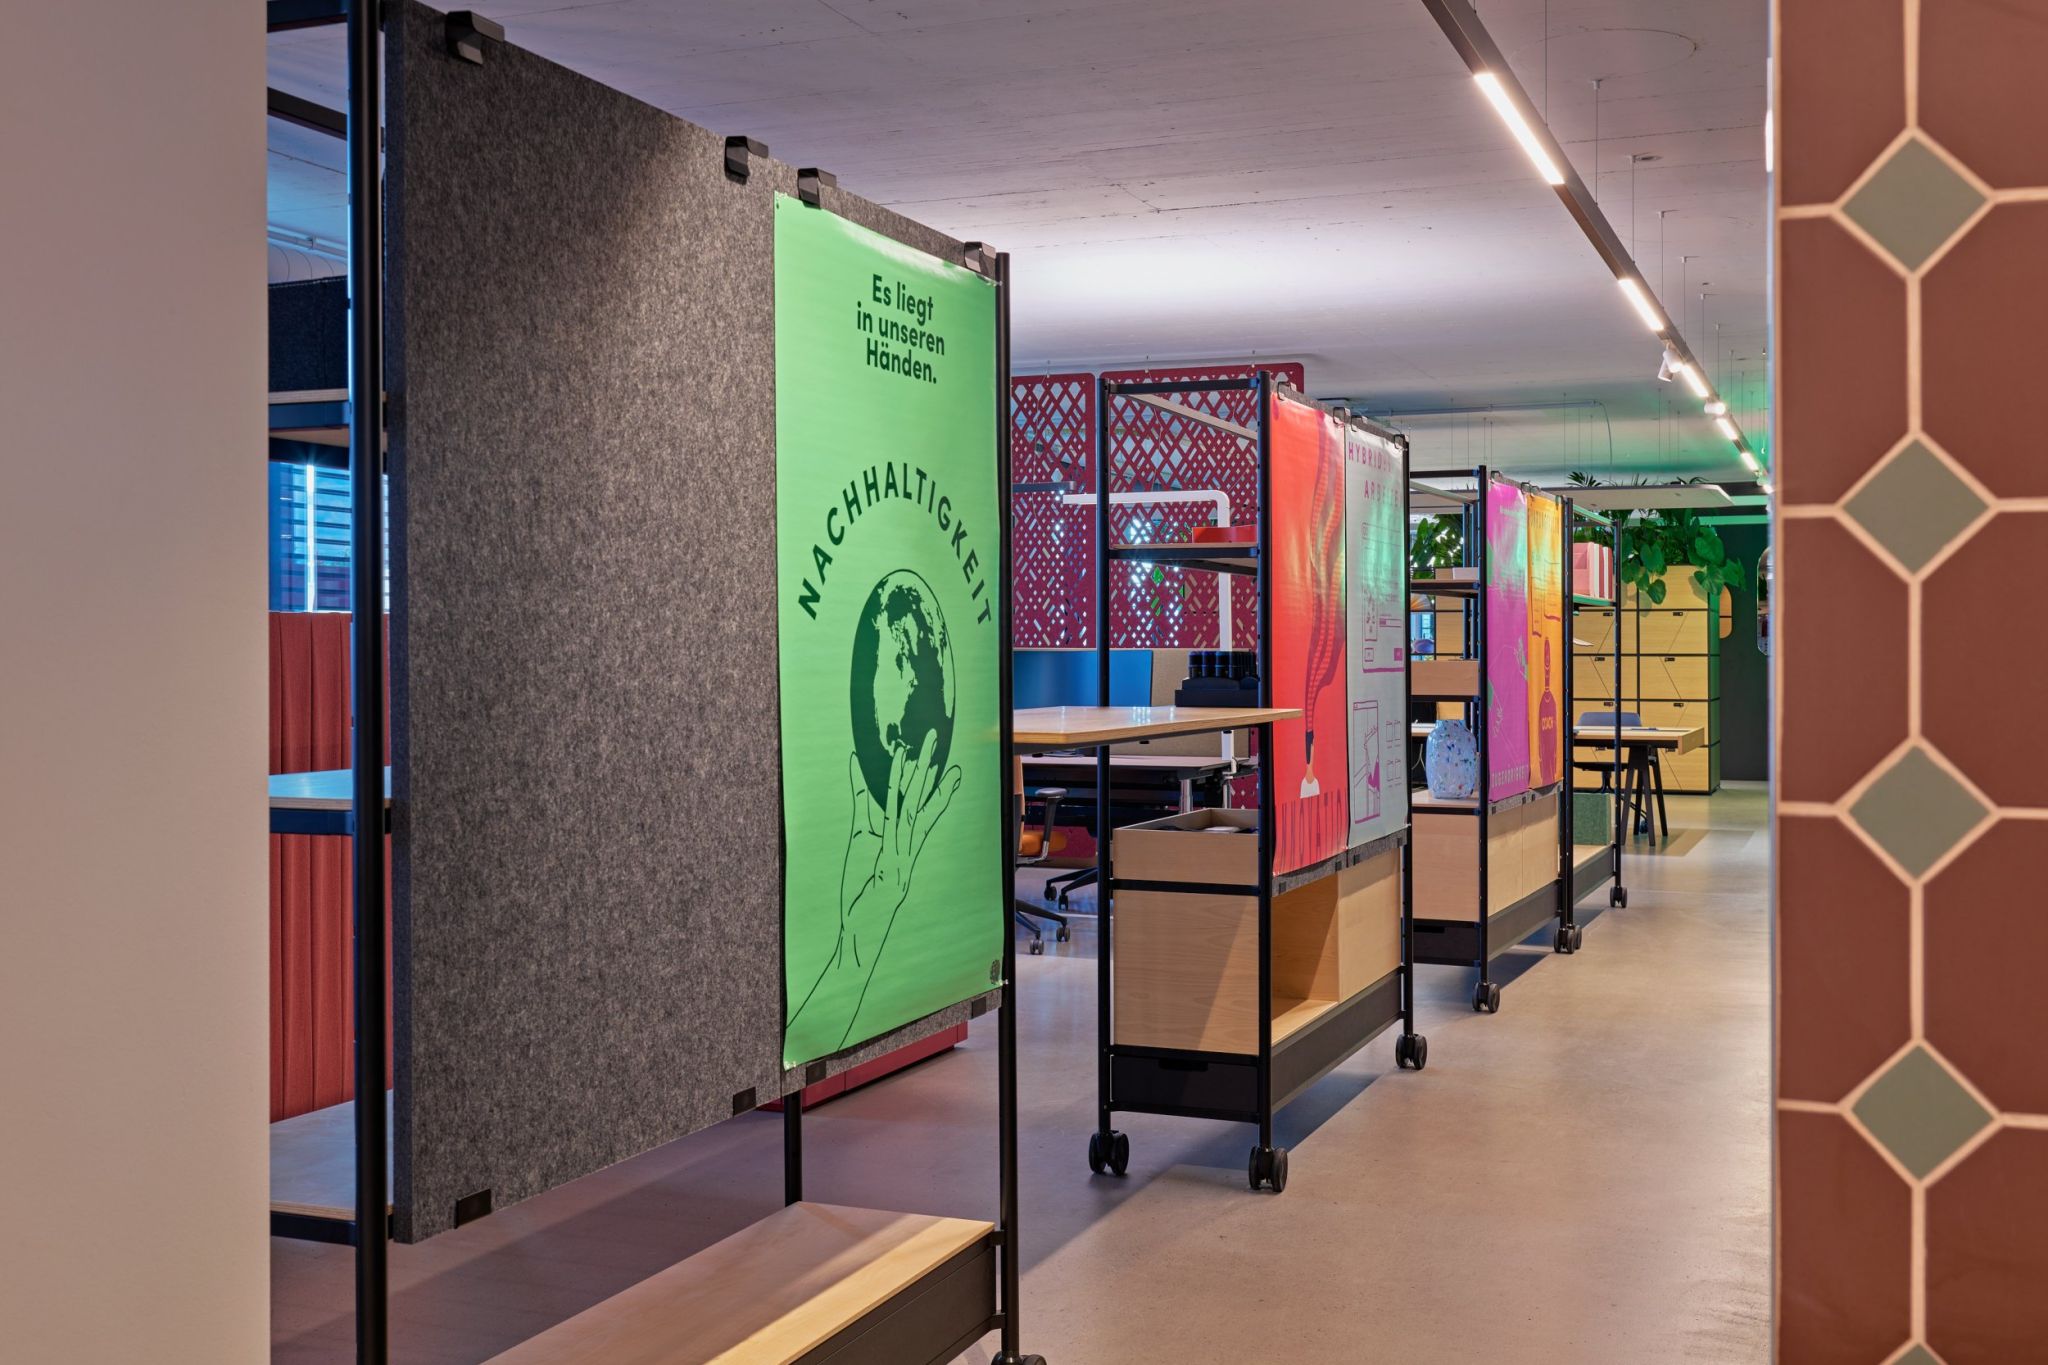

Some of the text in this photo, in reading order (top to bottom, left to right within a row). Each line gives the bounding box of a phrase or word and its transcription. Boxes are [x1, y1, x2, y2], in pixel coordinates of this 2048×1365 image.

[872, 274, 934, 322] Es liegt
[856, 301, 945, 356] in unseren
[866, 337, 937, 385] Händen.
[797, 461, 992, 626] NACHHALTIGKEIT
